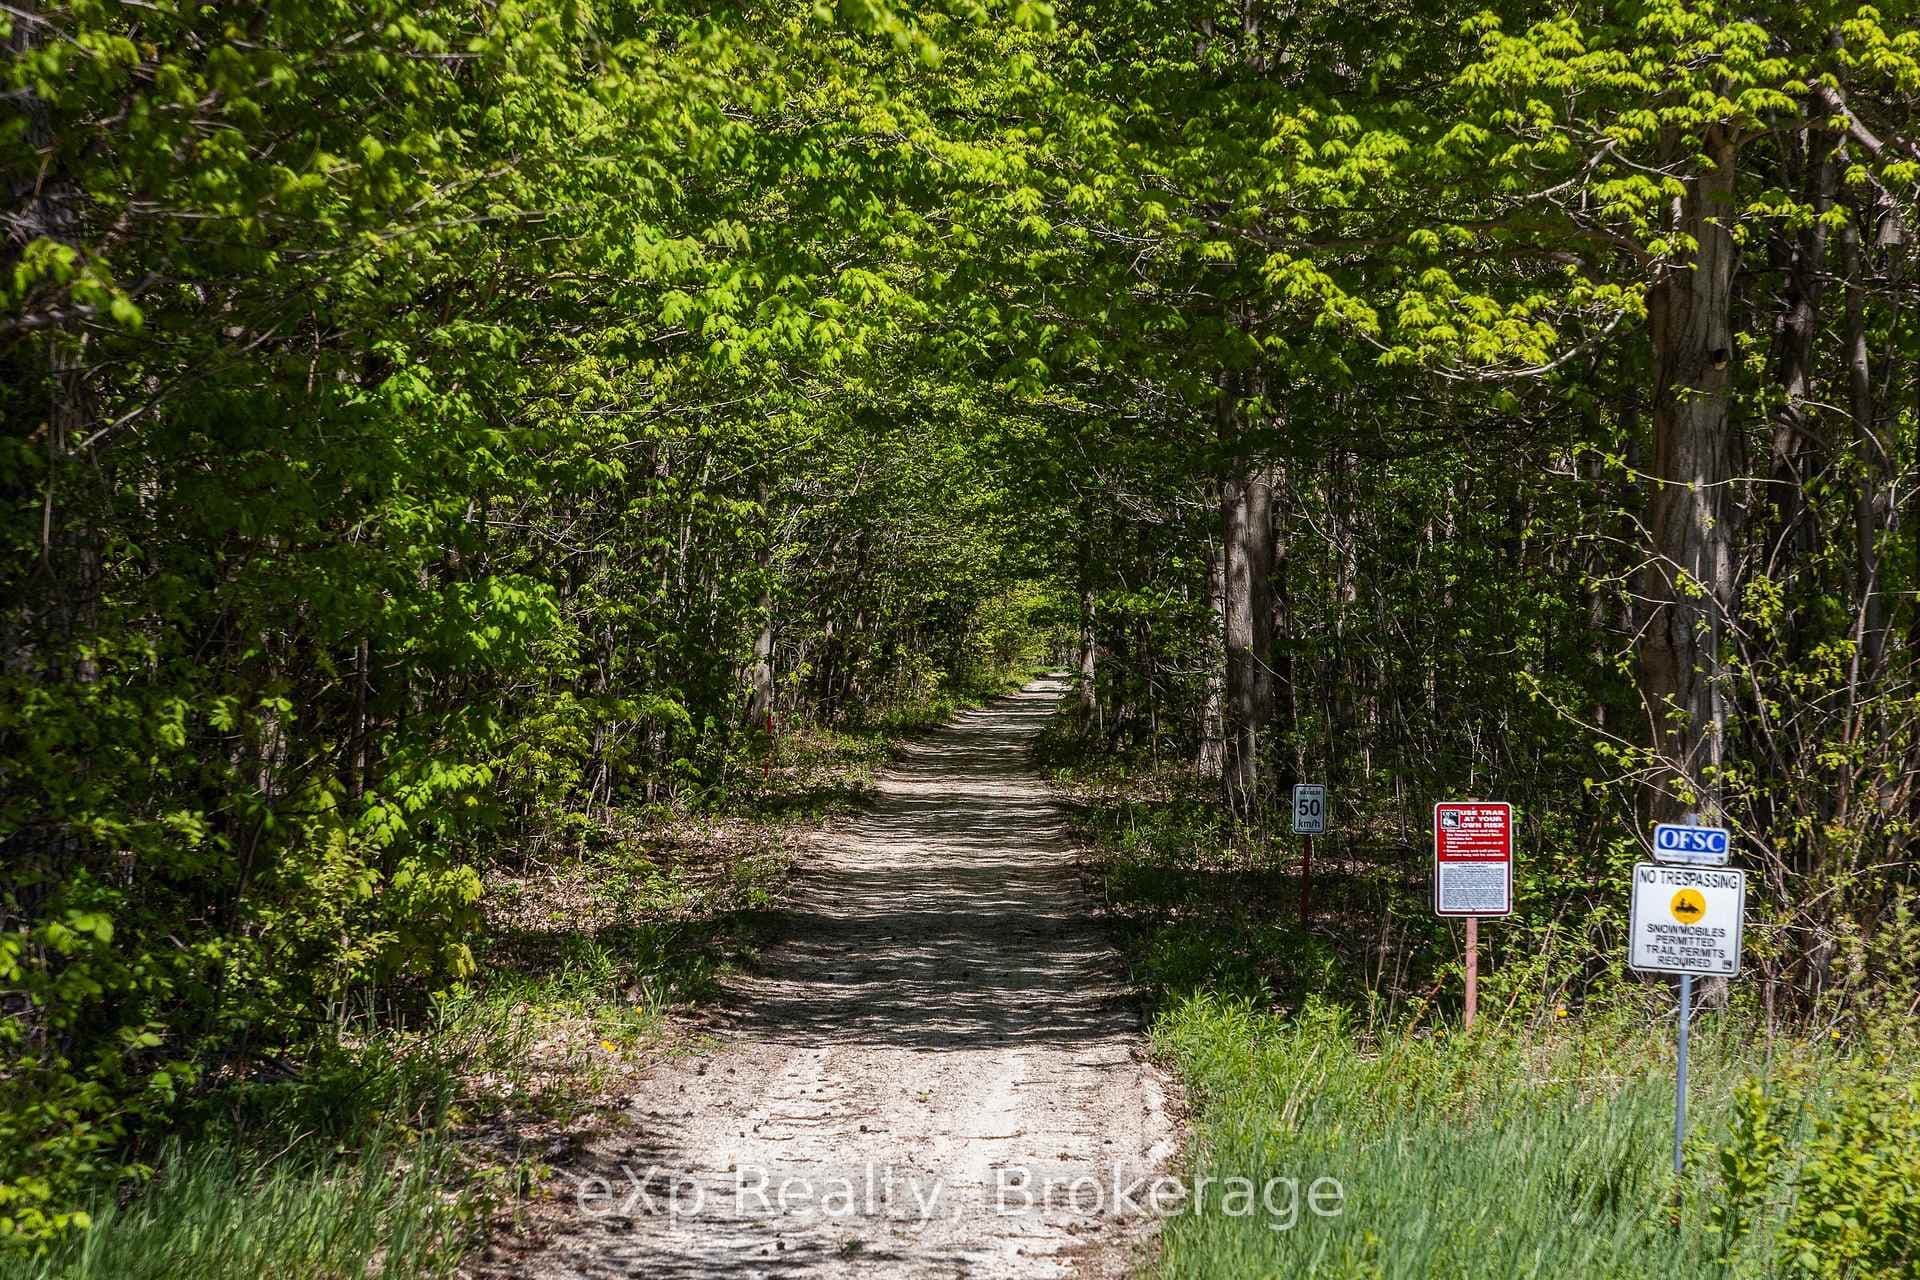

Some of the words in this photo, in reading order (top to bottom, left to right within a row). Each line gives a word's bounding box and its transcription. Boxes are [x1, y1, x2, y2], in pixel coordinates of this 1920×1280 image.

[1299, 799, 1320, 816] 50
[1299, 819, 1320, 828] km/h
[1660, 829, 1724, 851] OFSC
[1641, 870, 1656, 883] NO
[1660, 870, 1737, 889] TRESPASSING
[1647, 923, 1726, 937] SNOWMOBILES
[1656, 935, 1716, 947] PERMITTED
[1646, 944, 1676, 955] TRAIL
[1680, 946, 1725, 958] PERMITS
[1657, 956, 1711, 968] REQUIRED
